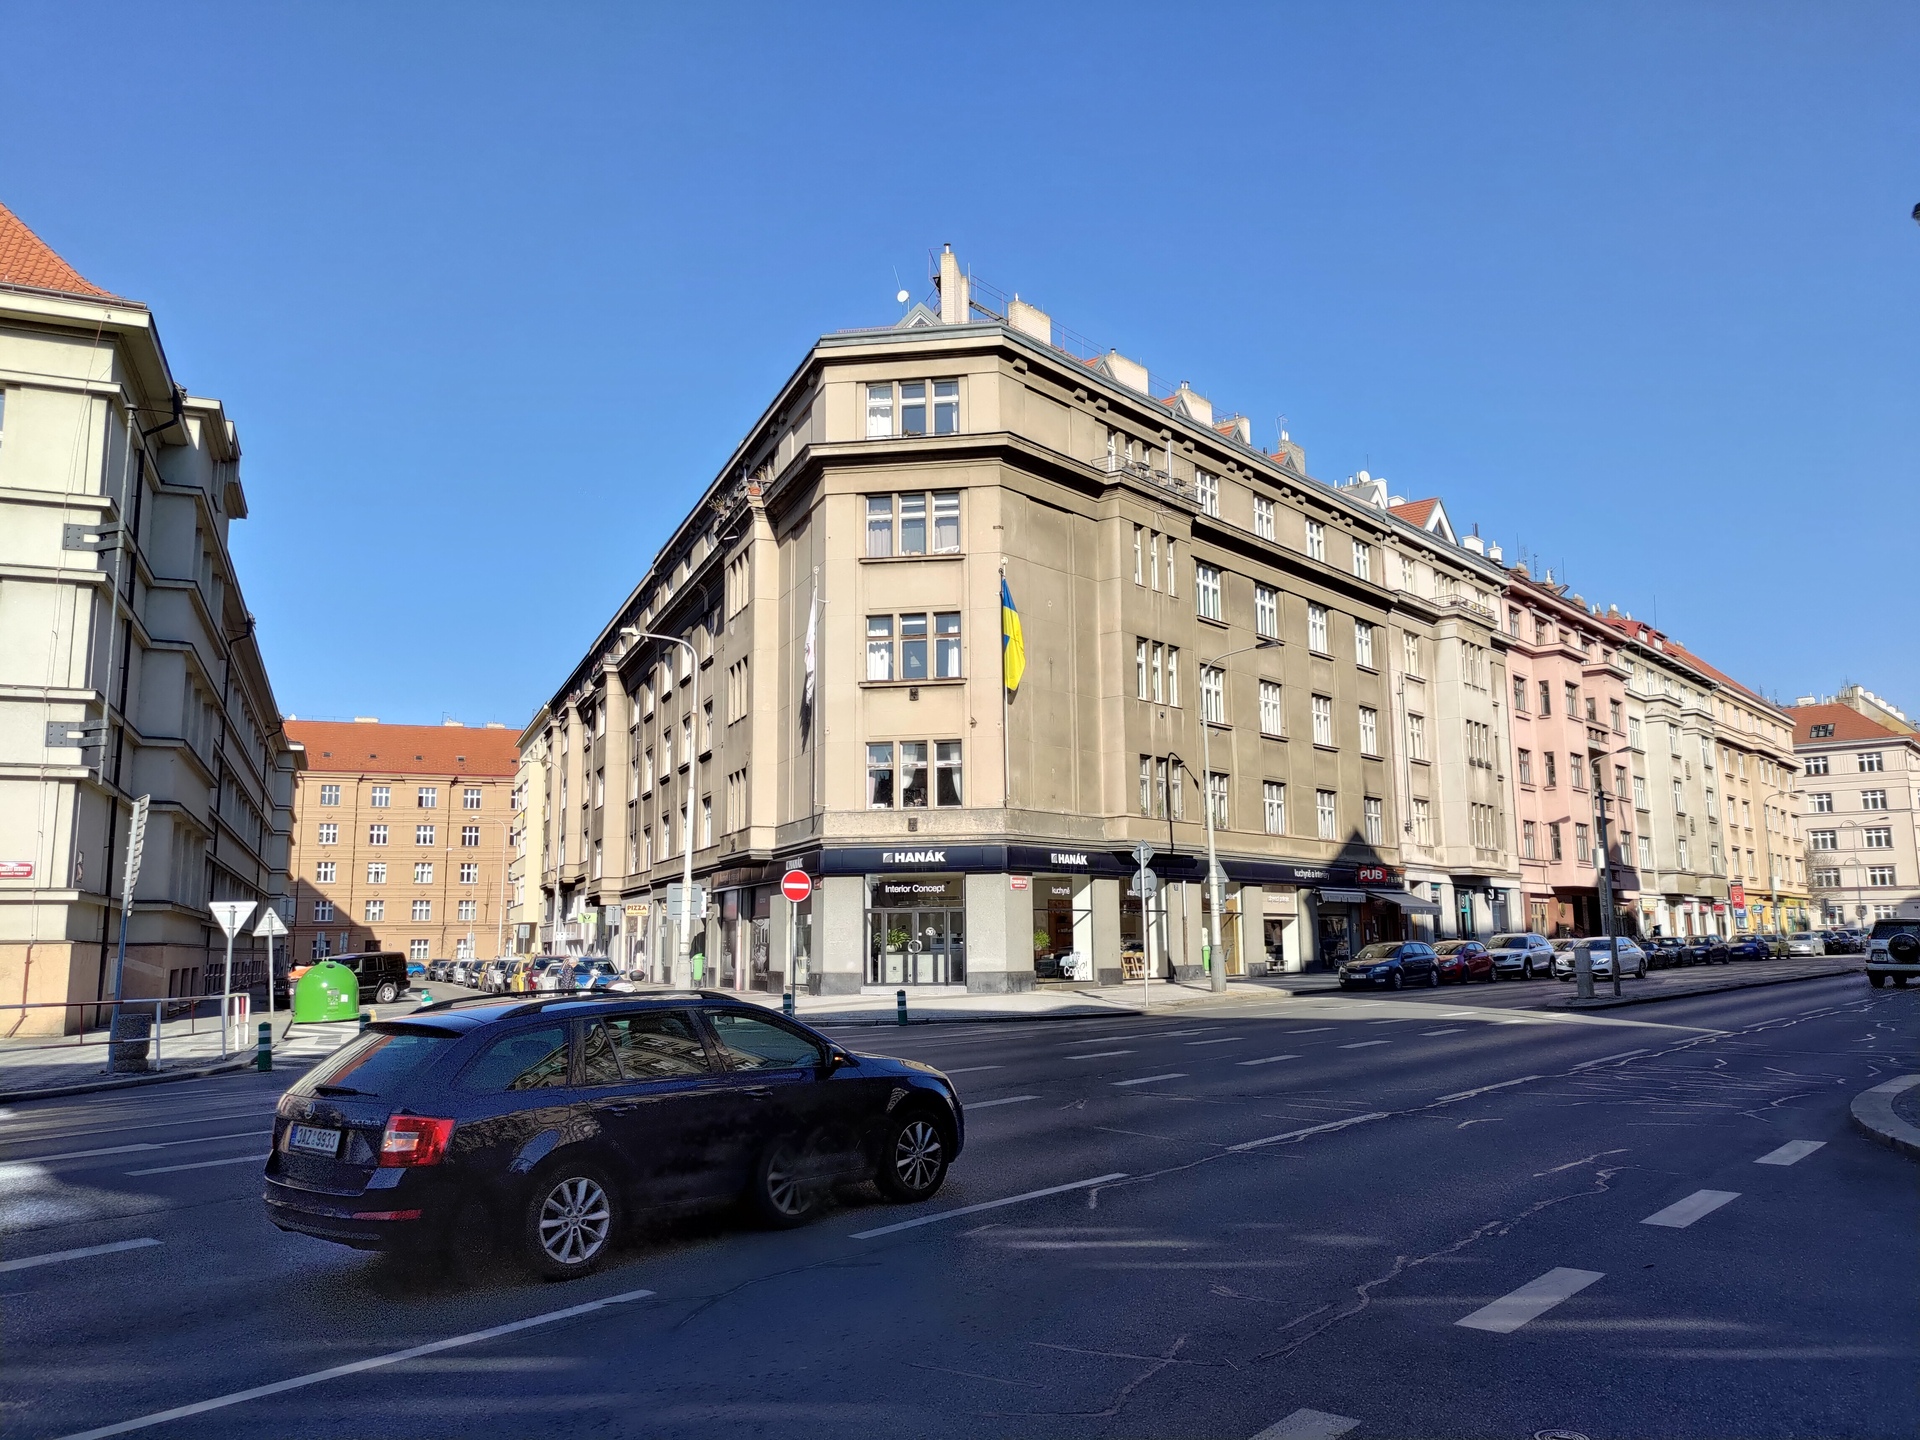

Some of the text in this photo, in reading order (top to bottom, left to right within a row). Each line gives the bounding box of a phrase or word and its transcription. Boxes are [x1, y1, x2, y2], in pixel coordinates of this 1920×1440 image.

[895, 850, 946, 863] HANÁK
[1058, 853, 1087, 864] HANÁK
[1360, 869, 1382, 879] PUB
[885, 884, 945, 894] Interior Concept
[1052, 887, 1070, 896] kuchyně
[297, 1128, 337, 1149] 3AZ 9933
